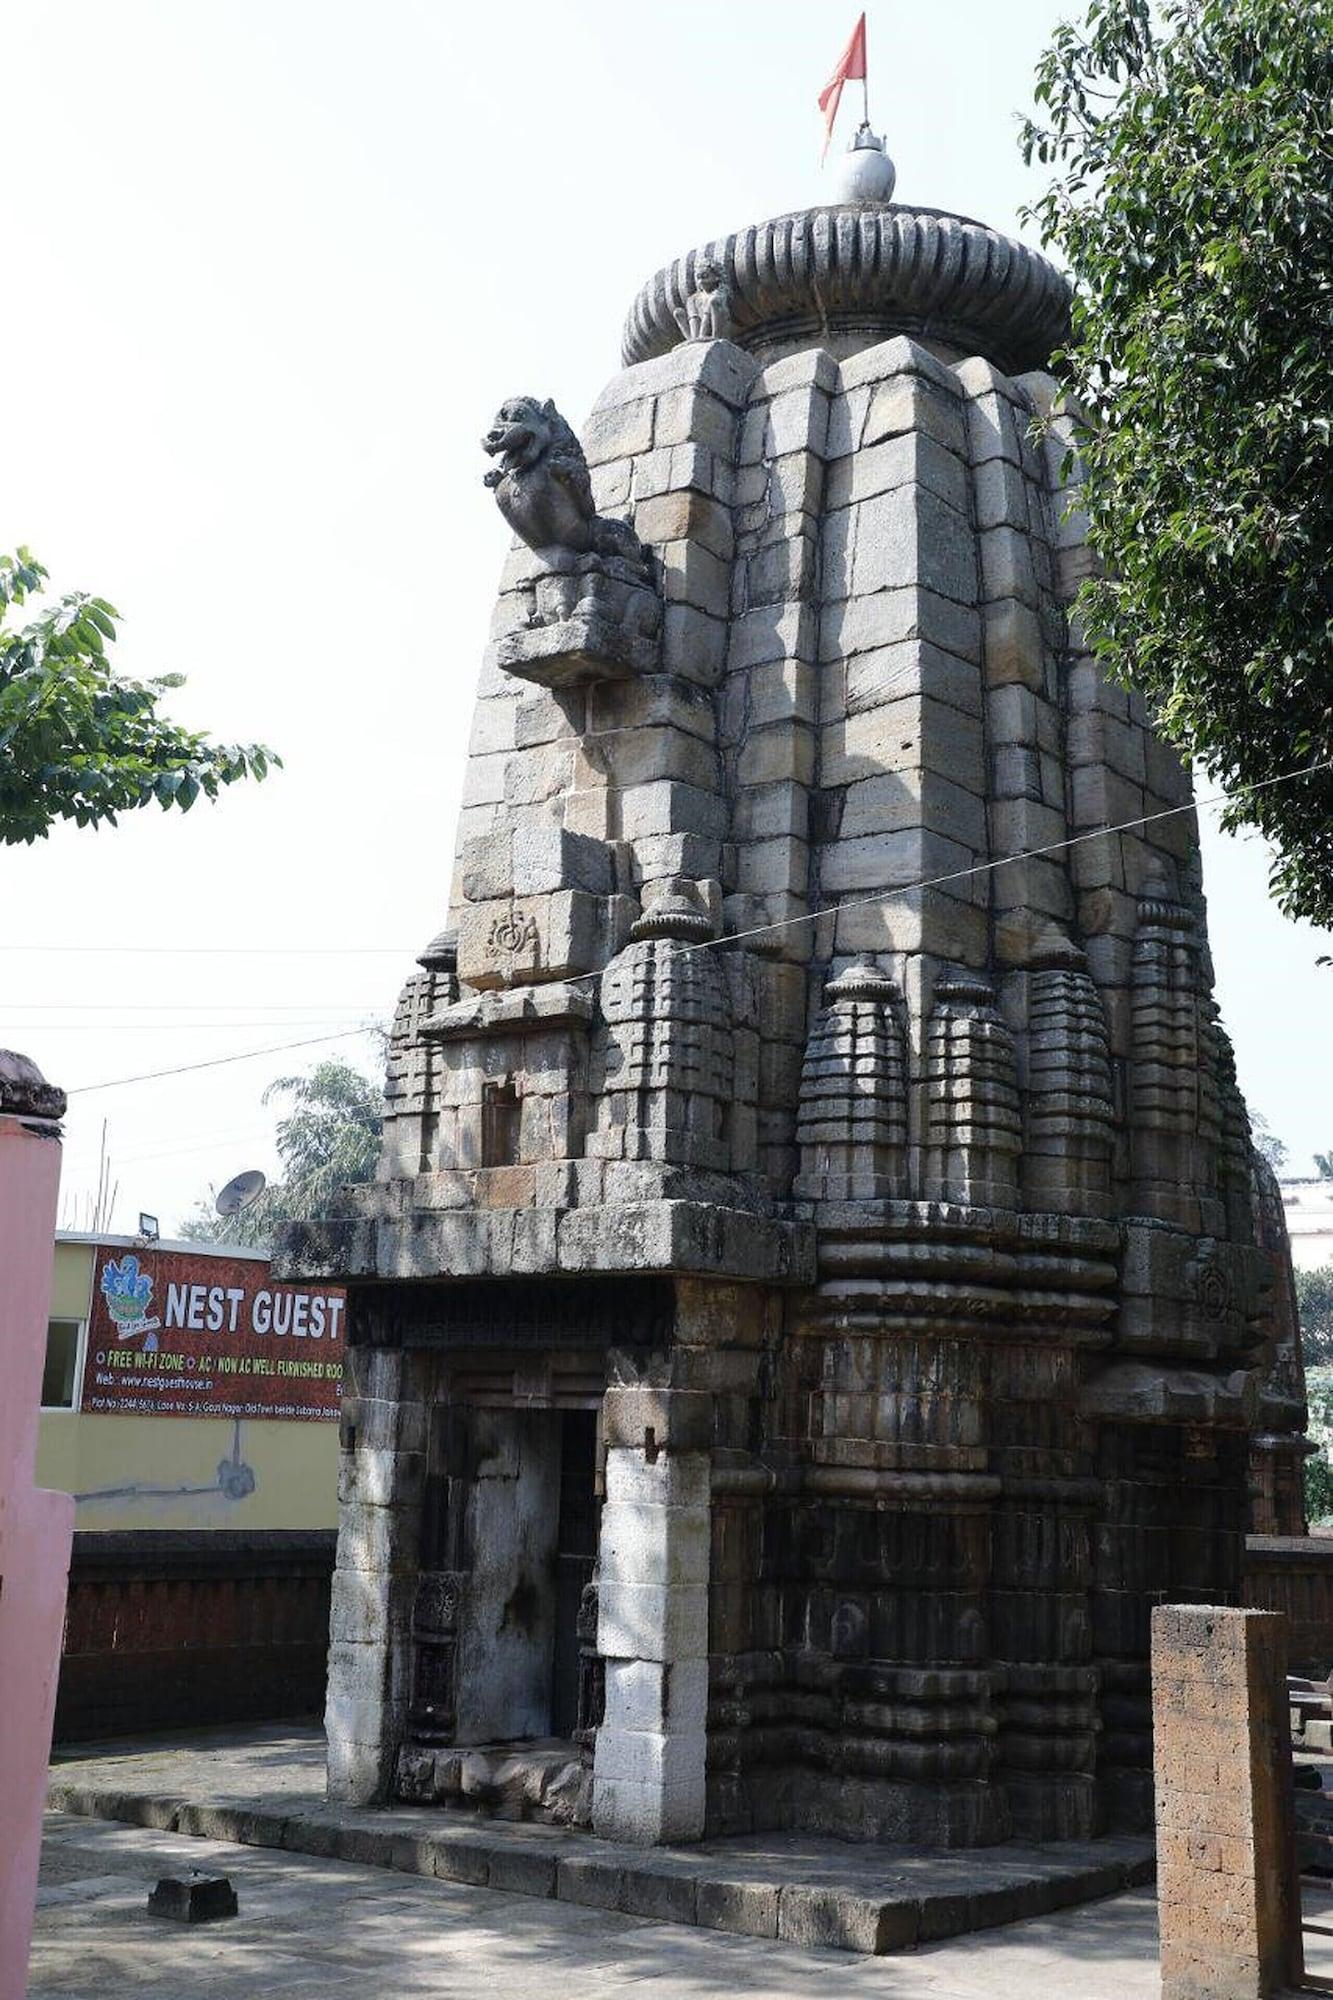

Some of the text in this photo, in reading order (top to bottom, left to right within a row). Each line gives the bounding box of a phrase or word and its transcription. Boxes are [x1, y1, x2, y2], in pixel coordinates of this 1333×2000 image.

[164, 1282, 244, 1332] NEST
[252, 1290, 344, 1339] GUEST
[107, 1350, 133, 1368] FREE
[158, 1353, 184, 1371] ZONE
[197, 1356, 211, 1372] AC
[238, 1358, 251, 1374] AC
[252, 1358, 276, 1376] WELL
[277, 1360, 325, 1378] FURNISHED
